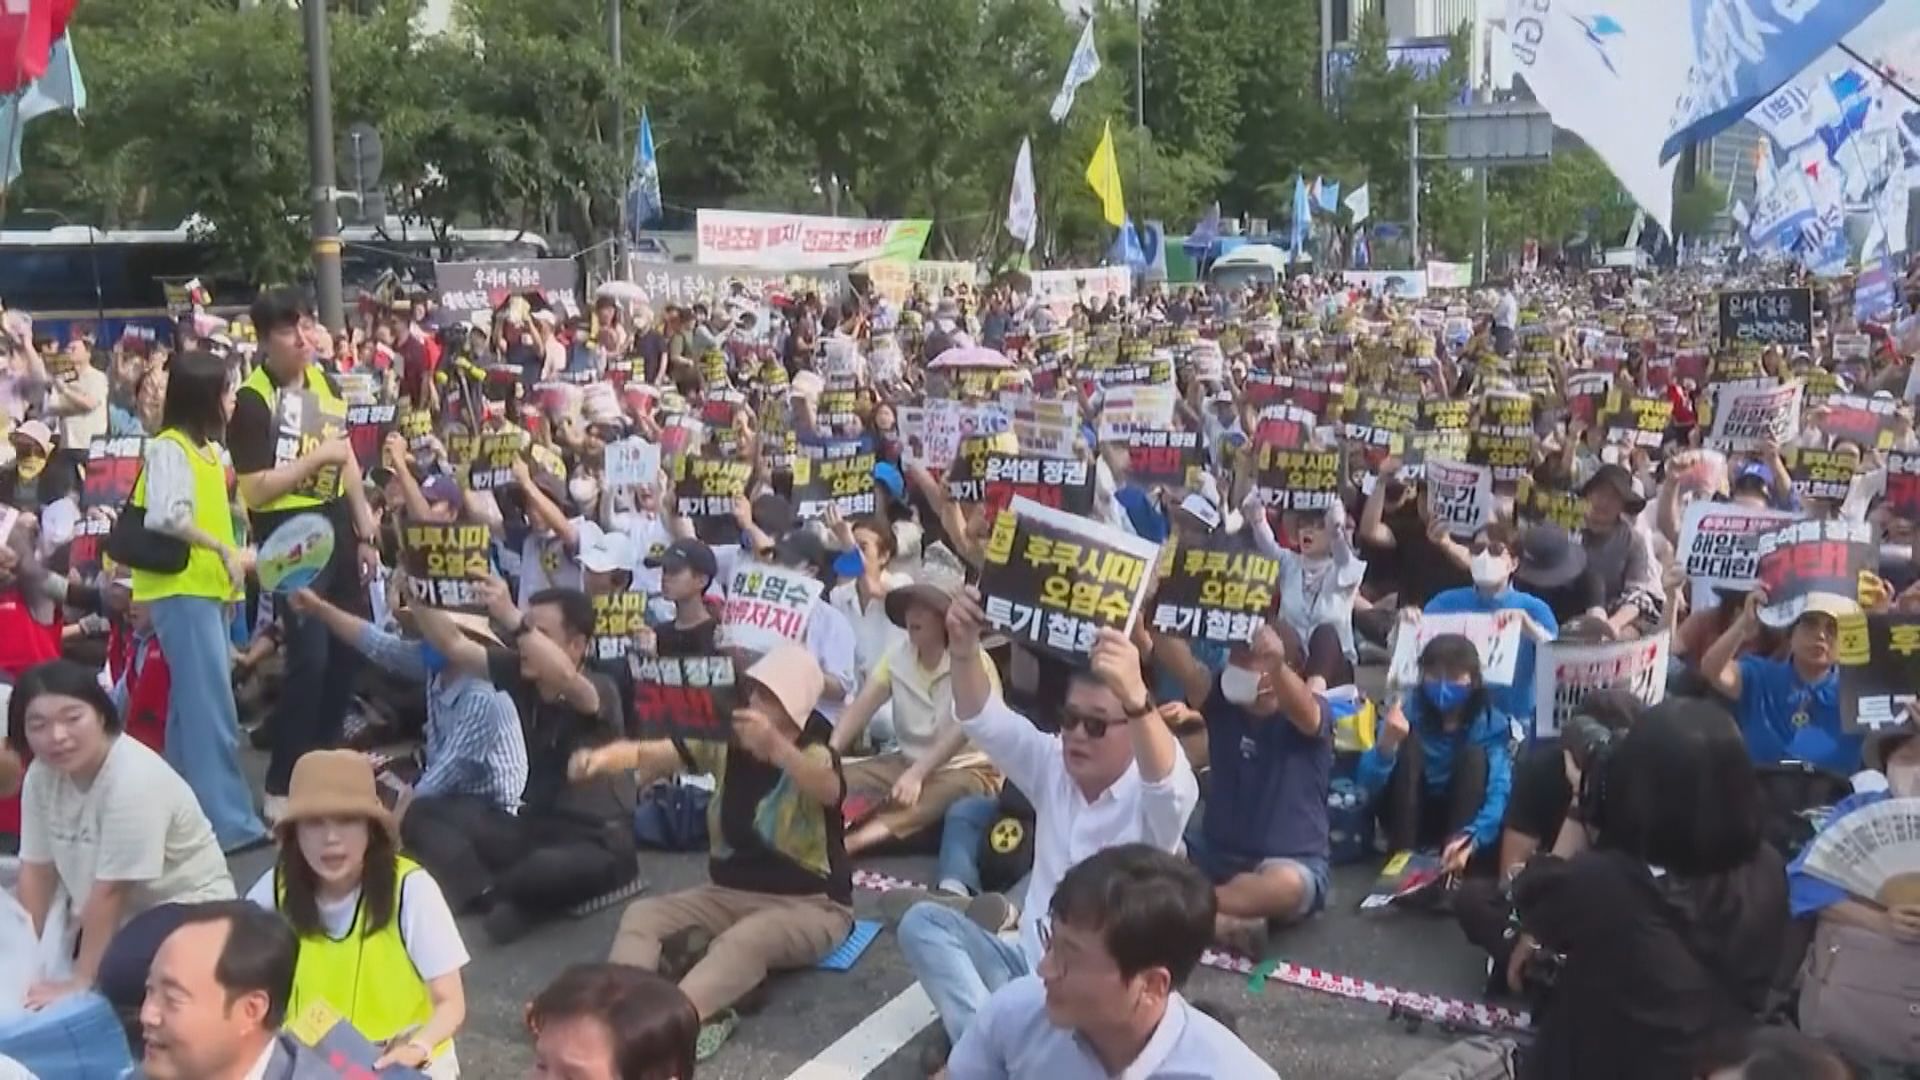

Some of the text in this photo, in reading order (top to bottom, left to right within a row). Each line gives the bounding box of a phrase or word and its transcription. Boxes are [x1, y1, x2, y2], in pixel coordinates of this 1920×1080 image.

[985, 457, 1039, 483] 윤석열
[1043, 459, 1088, 486] 정권
[1023, 533, 1145, 592] 후쿠시마
[1183, 549, 1280, 586] 후쿠시마
[1039, 575, 1131, 623] 오염수
[1199, 580, 1273, 613] 오염수
[985, 595, 1043, 642] 투기
[1152, 604, 1202, 637] 투기
